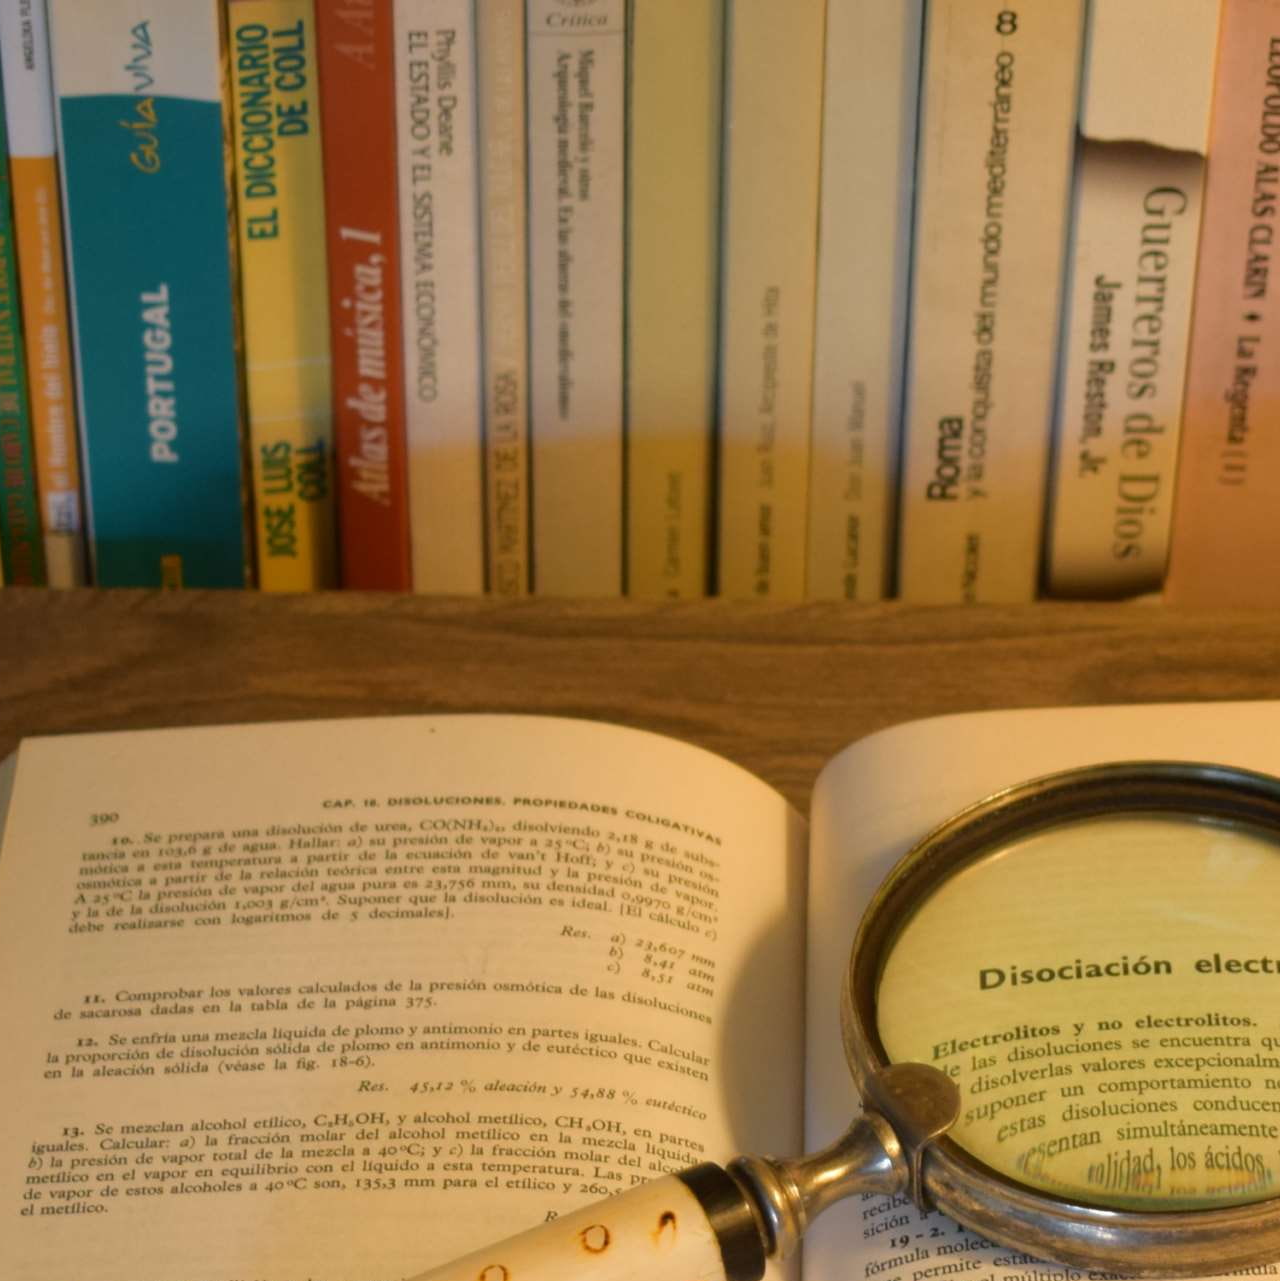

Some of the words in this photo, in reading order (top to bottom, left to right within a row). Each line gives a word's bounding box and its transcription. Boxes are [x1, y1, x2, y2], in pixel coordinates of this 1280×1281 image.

[407, 30, 429, 55] EL
[995, 10, 1019, 36] 8
[271, 18, 307, 93] COLL
[431, 27, 457, 91] Phyllis
[235, 23, 277, 198] DICCIONARIO
[275, 98, 310, 138] DE
[408, 59, 431, 141] ESTADO
[436, 94, 457, 158] Deane
[411, 144, 432, 159] Y
[411, 163, 432, 186] EL
[1250, 161, 1280, 217] ALAS
[247, 207, 281, 241] EL
[339, 226, 382, 246] 1
[411, 191, 435, 275] SISTEMA
[979, 221, 1004, 308] mundo
[341, 253, 386, 379] música,
[1088, 273, 1124, 353] James
[1131, 186, 1186, 400] Guerreros
[972, 312, 996, 345] del
[1235, 335, 1259, 359] La
[143, 283, 179, 463] PORTUGAL
[344, 382, 388, 422] de
[972, 348, 994, 459] conquista
[1223, 365, 1258, 445] Regenta
[925, 415, 964, 502] Roma
[1121, 412, 1167, 460] de
[260, 439, 293, 496] LUIS
[295, 435, 326, 502] COLL
[347, 426, 391, 506] Atlas
[966, 488, 989, 501] y
[1115, 473, 1161, 558] Dios
[89, 811, 120, 827] 390
[512, 797, 618, 816] PROPIEDADES
[625, 809, 722, 846] COLIGATIVAS
[978, 955, 1173, 991] Disociación
[76, 1038, 98, 1048] 12.
[109, 1034, 128, 1046] Se
[132, 1032, 176, 1046] enfría
[182, 1032, 210, 1043] una
[214, 1029, 267, 1042] mezcla
[331, 1026, 351, 1037] de
[355, 1024, 404, 1039] plomo
[409, 1026, 418, 1037] y
[422, 1022, 502, 1036] antimonio
[508, 1026, 526, 1035] en
[532, 1025, 580, 1041] partes
[585, 1030, 644, 1049] iguales.
[648, 1038, 711, 1067] Calcular
[930, 1023, 1062, 1061] Electrolitos
[1072, 1022, 1085, 1037] y
[1097, 1019, 1123, 1032] no
[1134, 1012, 1258, 1030] electrolitos.
[971, 1055, 997, 1073] las
[1007, 1035, 1122, 1064] disoluciones
[1131, 1036, 1150, 1049] se
[1159, 1034, 1251, 1049] encuentra
[964, 1088, 1048, 1127] suponer
[1060, 1082, 1085, 1098] un
[1097, 1075, 1252, 1096] comportamiento
[970, 1063, 1073, 1095] disolverlas
[1081, 1057, 1146, 1074] valores
